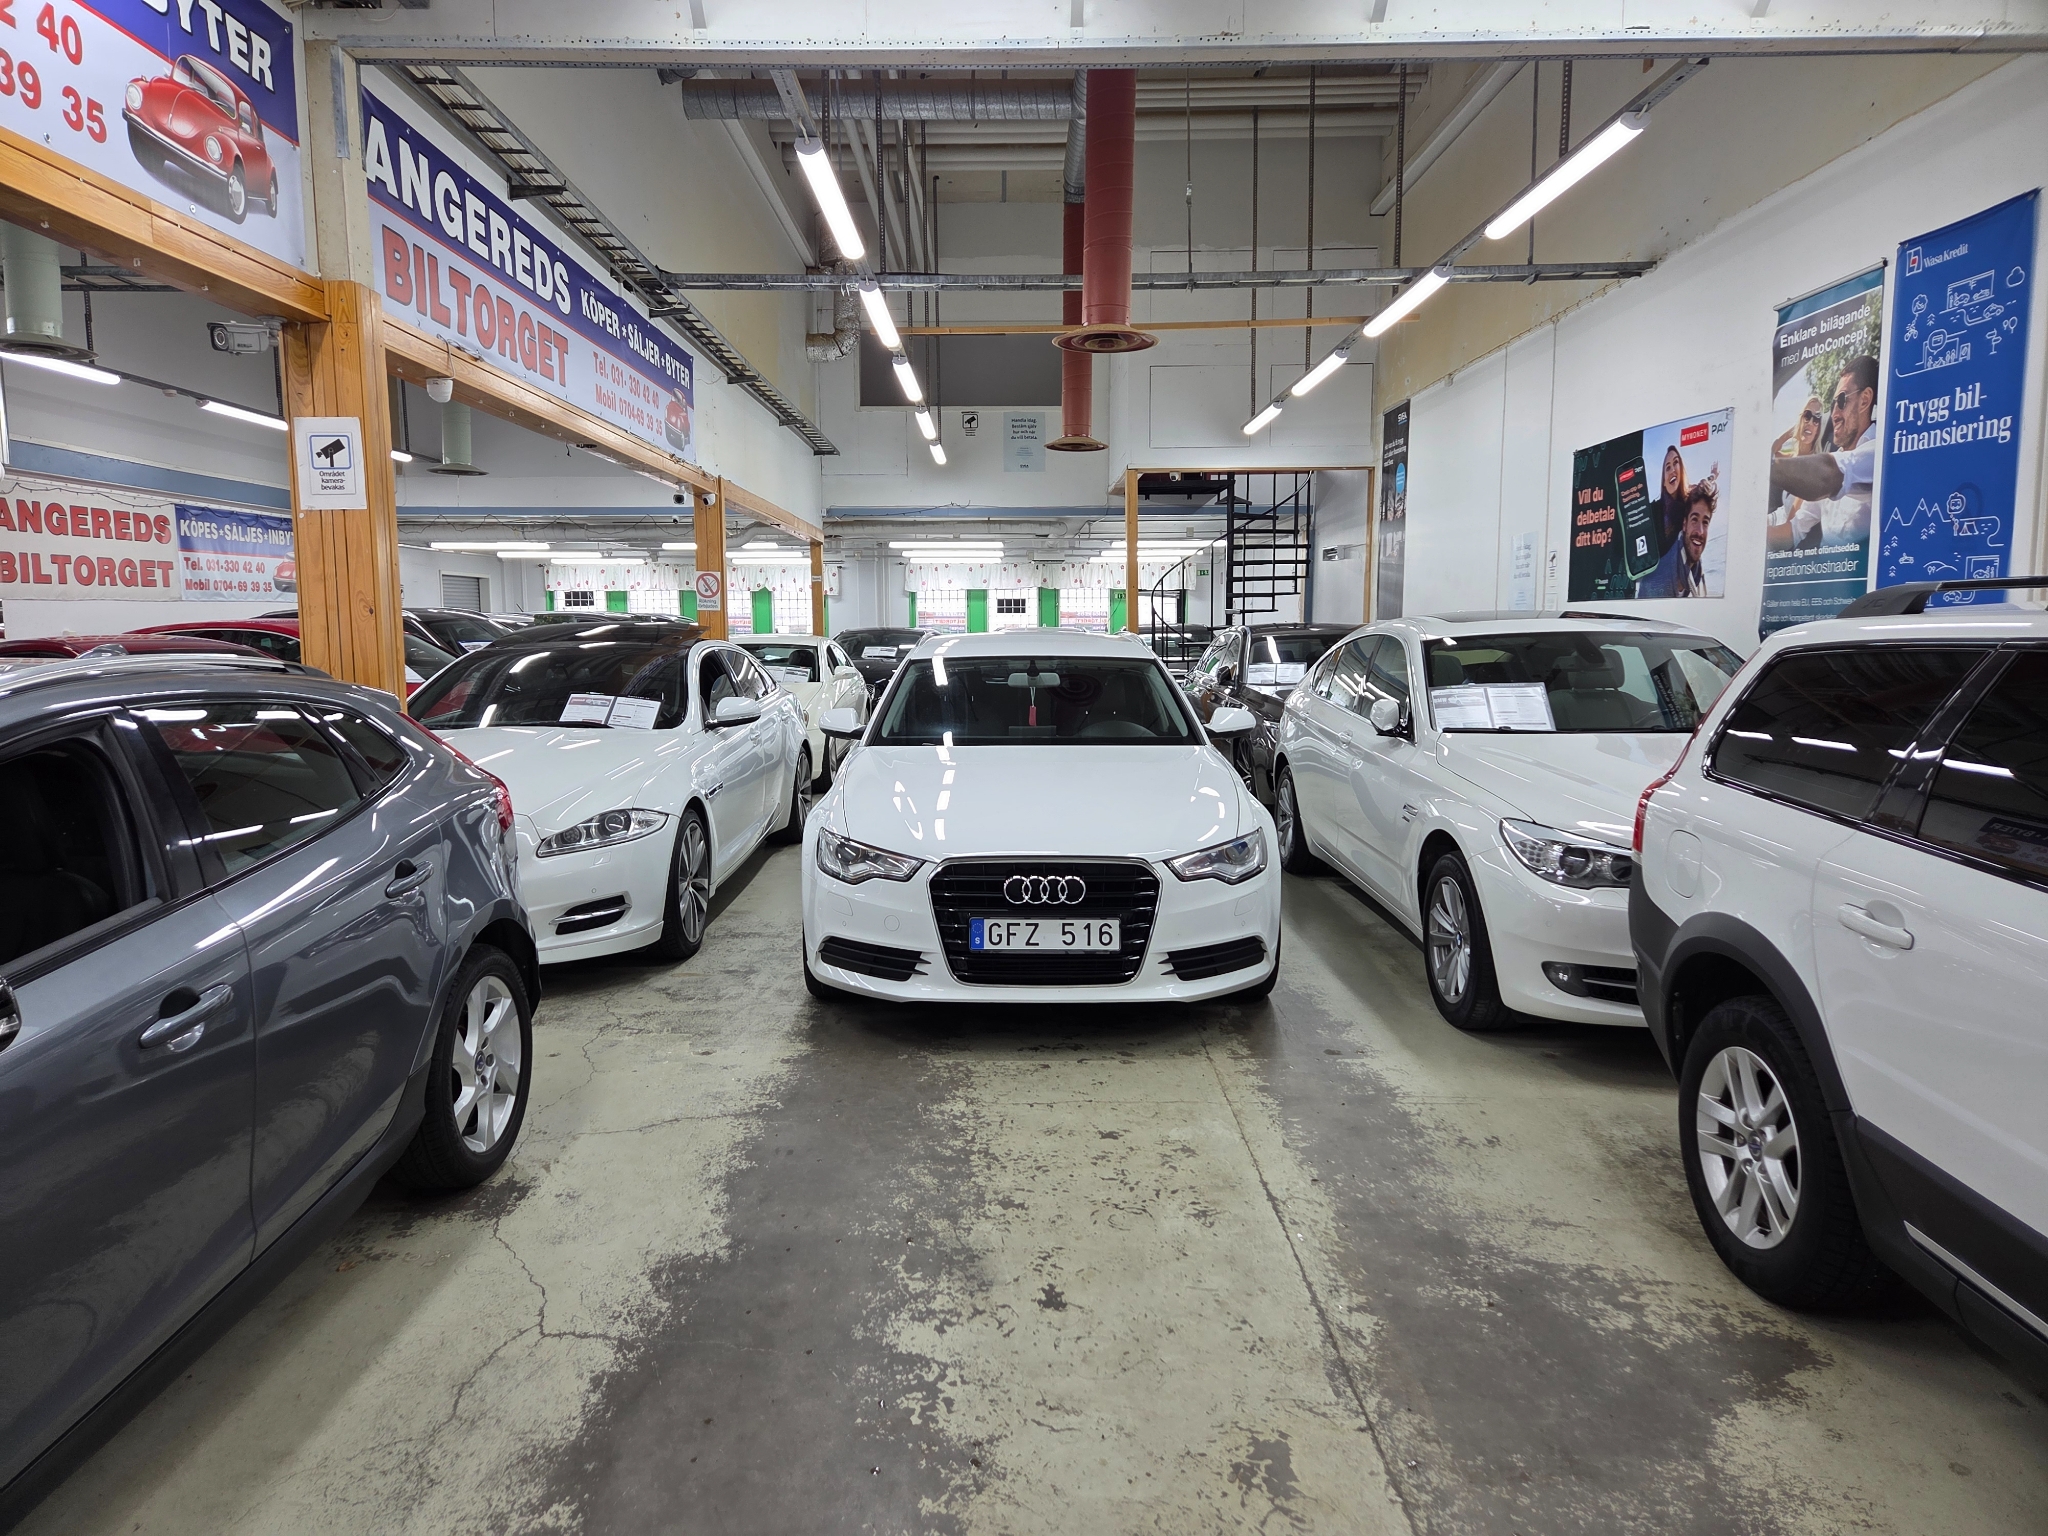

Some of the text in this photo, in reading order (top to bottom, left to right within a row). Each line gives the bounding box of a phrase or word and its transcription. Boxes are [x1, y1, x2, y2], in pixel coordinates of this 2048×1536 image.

[61, 85, 108, 144] 35
[366, 115, 572, 316] ANGEREDS
[1923, 243, 1969, 268] Wasa Kredit
[381, 223, 569, 387] BILTORGET
[580, 288, 690, 390] KÖPER SÄLJER BYTER
[1780, 304, 1871, 349] Enklare bilägande
[1781, 325, 1868, 368] med AutoConcept
[593, 351, 609, 380] Tel.
[628, 374, 641, 400] 330
[643, 385, 650, 405] 42
[652, 391, 660, 410] 40
[595, 383, 617, 412] Mobil
[646, 414, 654, 433] 39
[655, 420, 663, 437] 35
[1896, 382, 1988, 426] Trygg bil-
[1711, 421, 1729, 436] PAY
[1892, 415, 2013, 455] finansiering
[1578, 487, 1591, 505] Vill
[1592, 486, 1604, 502] du
[0, 497, 172, 545] ANGEREDS
[1576, 505, 1616, 526] delbetala
[180, 517, 219, 540] KÖPES
[224, 523, 264, 544] SÄLJES
[1575, 527, 1613, 548] ditt köp?
[1766, 542, 1860, 560] Försäkra dig mot oförutsedda
[0, 551, 174, 588] BILTORGET
[183, 556, 266, 574] Tel. 031-330 42 40
[1766, 557, 1859, 580] reparationskostnader
[184, 578, 273, 593] Mobil 0704-69 39 35
[1811, 597, 1822, 606] EES
[974, 937, 981, 945] S
[988, 922, 1113, 947] GFZ 516
